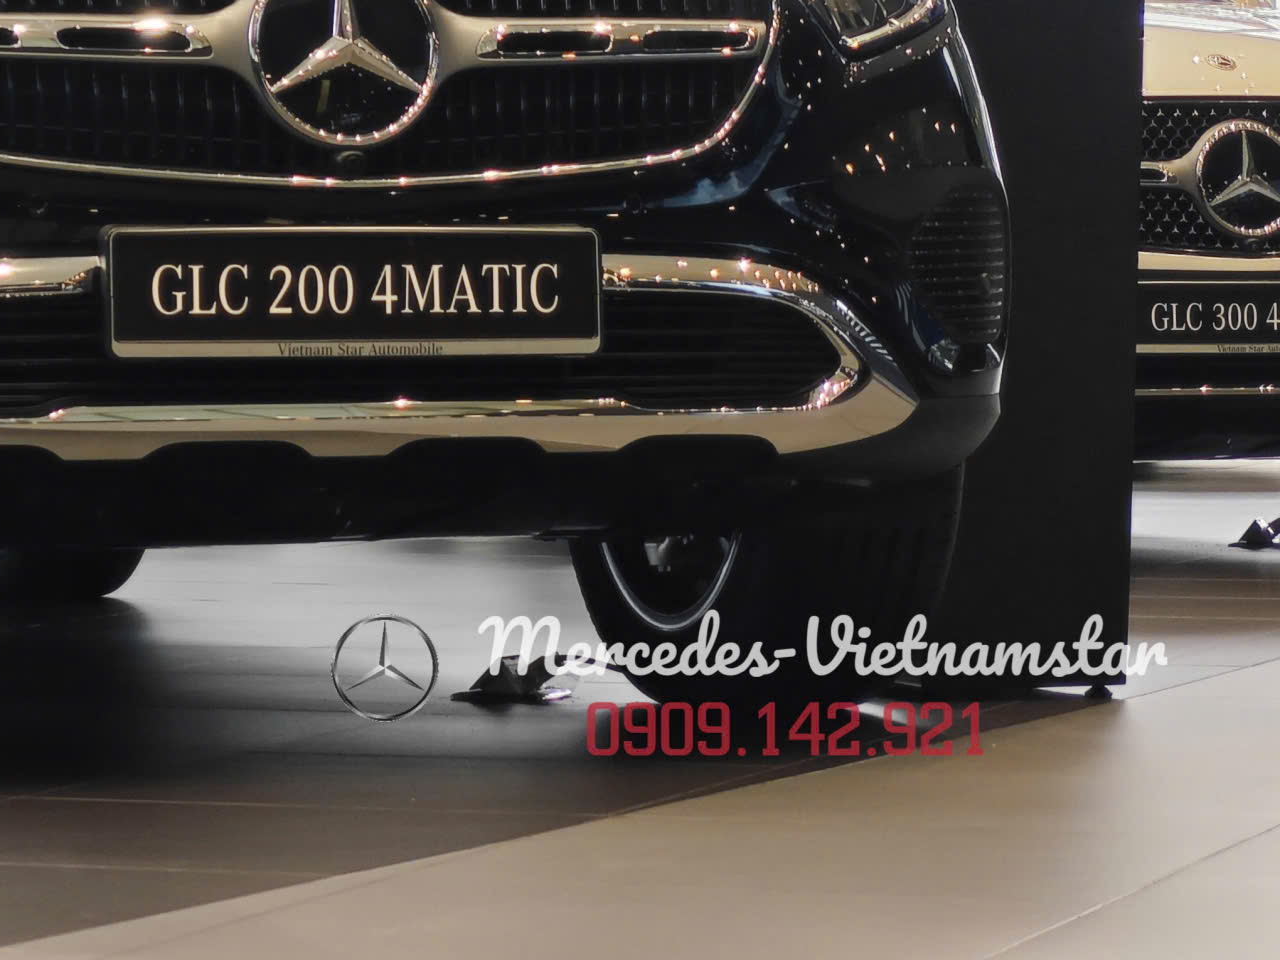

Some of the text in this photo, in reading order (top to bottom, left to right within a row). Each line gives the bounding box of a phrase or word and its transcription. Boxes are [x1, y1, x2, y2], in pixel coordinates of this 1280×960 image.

[151, 262, 559, 316] GLC 200 4MATIC
[1151, 302, 1203, 331] GLC
[1212, 302, 1258, 331] 300
[278, 342, 443, 356] Vietnam Star Automobile
